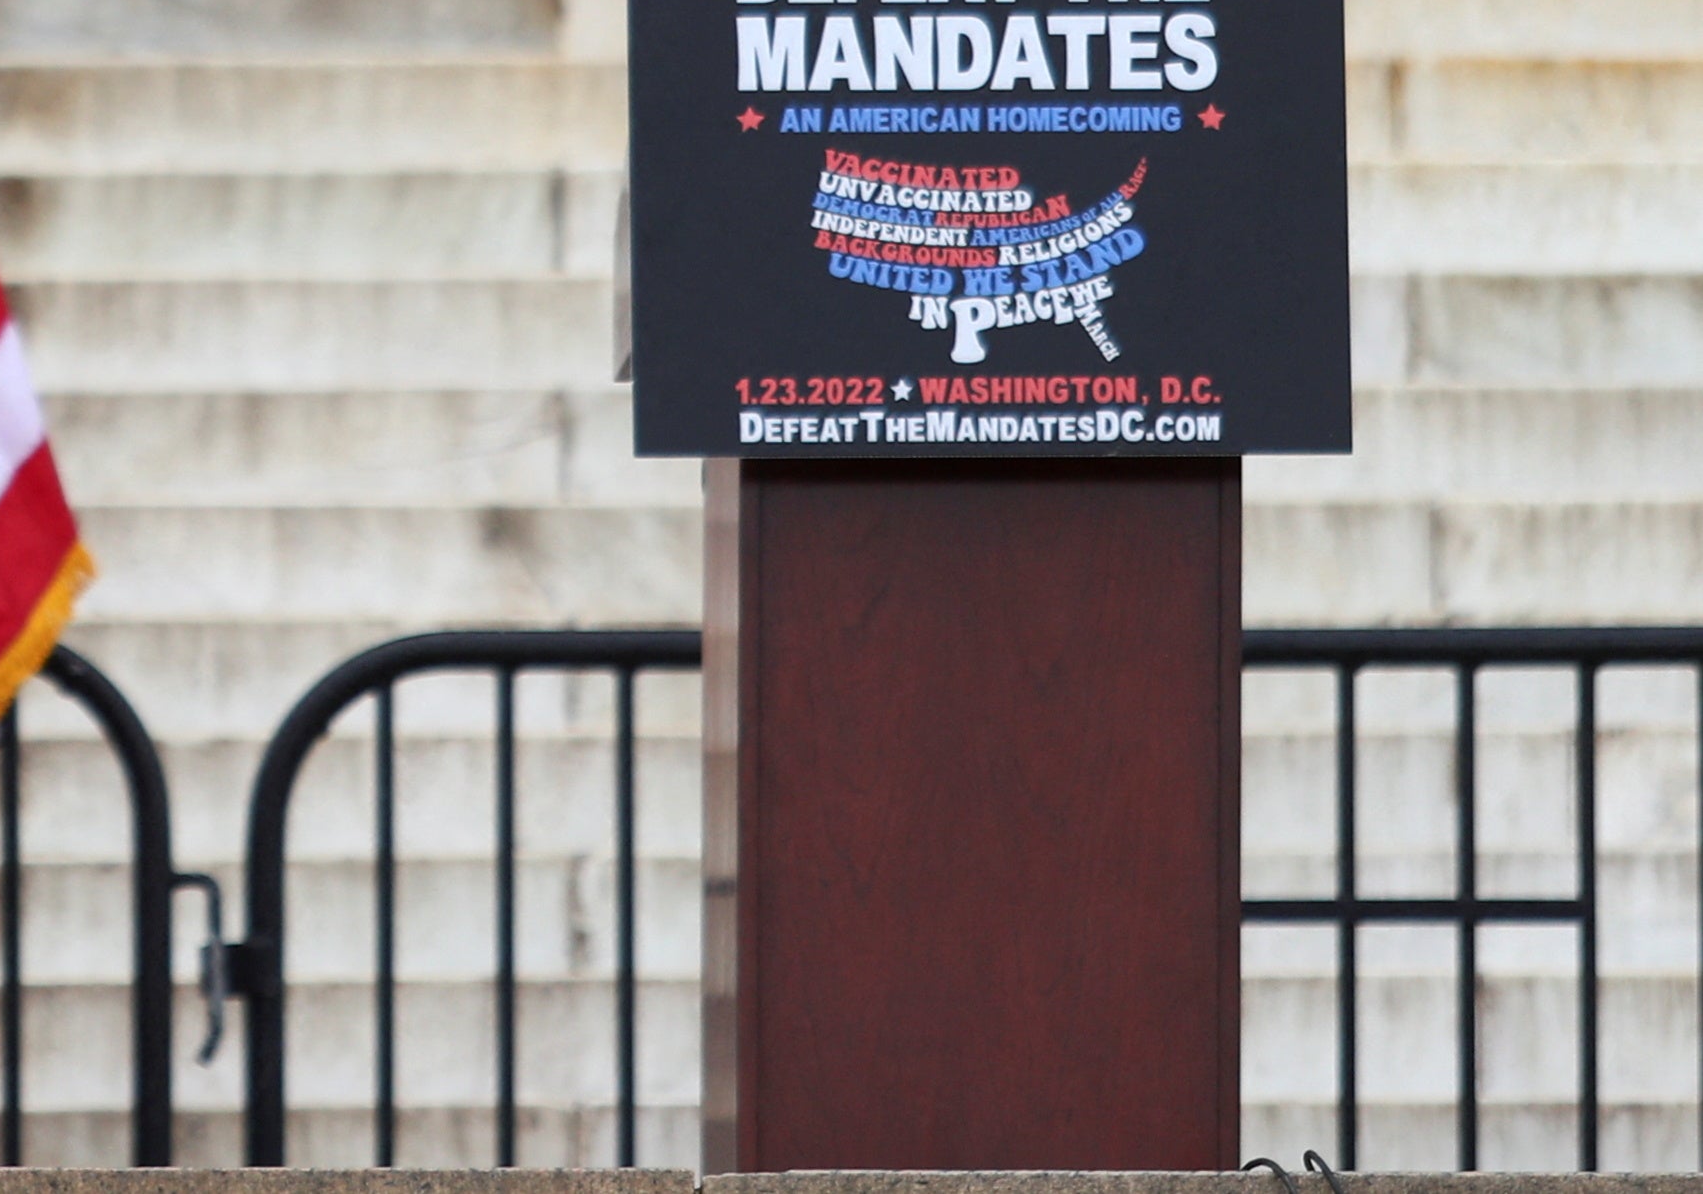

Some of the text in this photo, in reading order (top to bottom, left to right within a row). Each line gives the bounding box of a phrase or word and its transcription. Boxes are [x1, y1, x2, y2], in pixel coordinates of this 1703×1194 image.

[736, 14, 1217, 91] MANDATES
[780, 106, 1182, 133] AN AMERICAN HOMECOMING
[825, 149, 1020, 191] VACCINATED
[812, 192, 1072, 228] DEMOCRAT REPUBLICAN
[818, 172, 1033, 213] UNVACCINATED
[810, 211, 969, 246] INDEPENDENT
[970, 215, 1081, 246] AMERICANS
[813, 202, 1134, 267] BACKGROUNDS RELIGIONS
[827, 228, 1147, 296] UNITED WE STAND
[907, 275, 1114, 364] IN PEACE WE
[1074, 302, 1121, 363] MARCH
[736, 378, 1220, 406] 1.23.2022 WASHINGTON, D.C.
